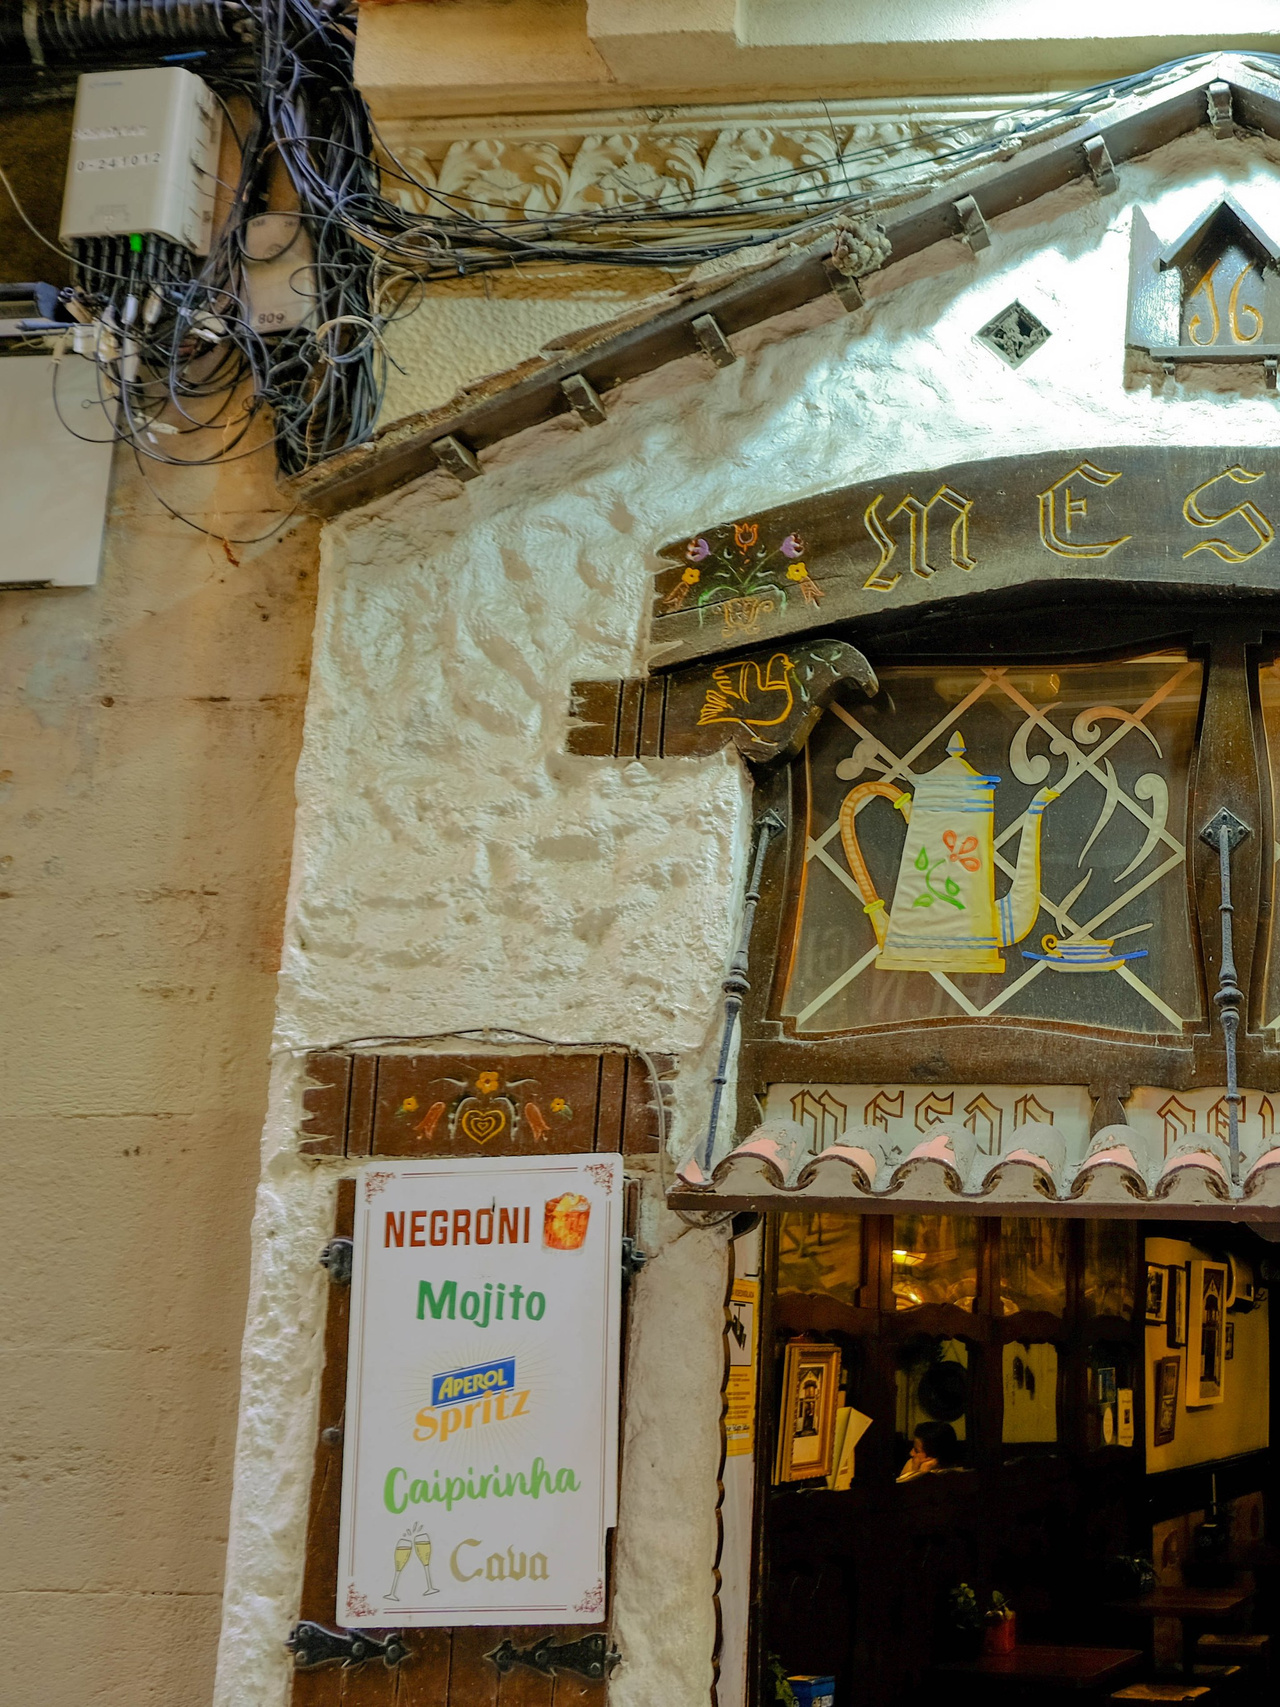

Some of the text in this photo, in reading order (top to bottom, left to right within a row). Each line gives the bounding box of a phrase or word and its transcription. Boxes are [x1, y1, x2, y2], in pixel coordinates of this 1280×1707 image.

[384, 1206, 531, 1249] NEGRONI
[416, 1279, 546, 1329] Mojito
[438, 1368, 508, 1401] APEROL
[413, 1389, 532, 1443] Spritz
[383, 1456, 582, 1515] Caipirinha
[450, 1538, 550, 1583] Cava
